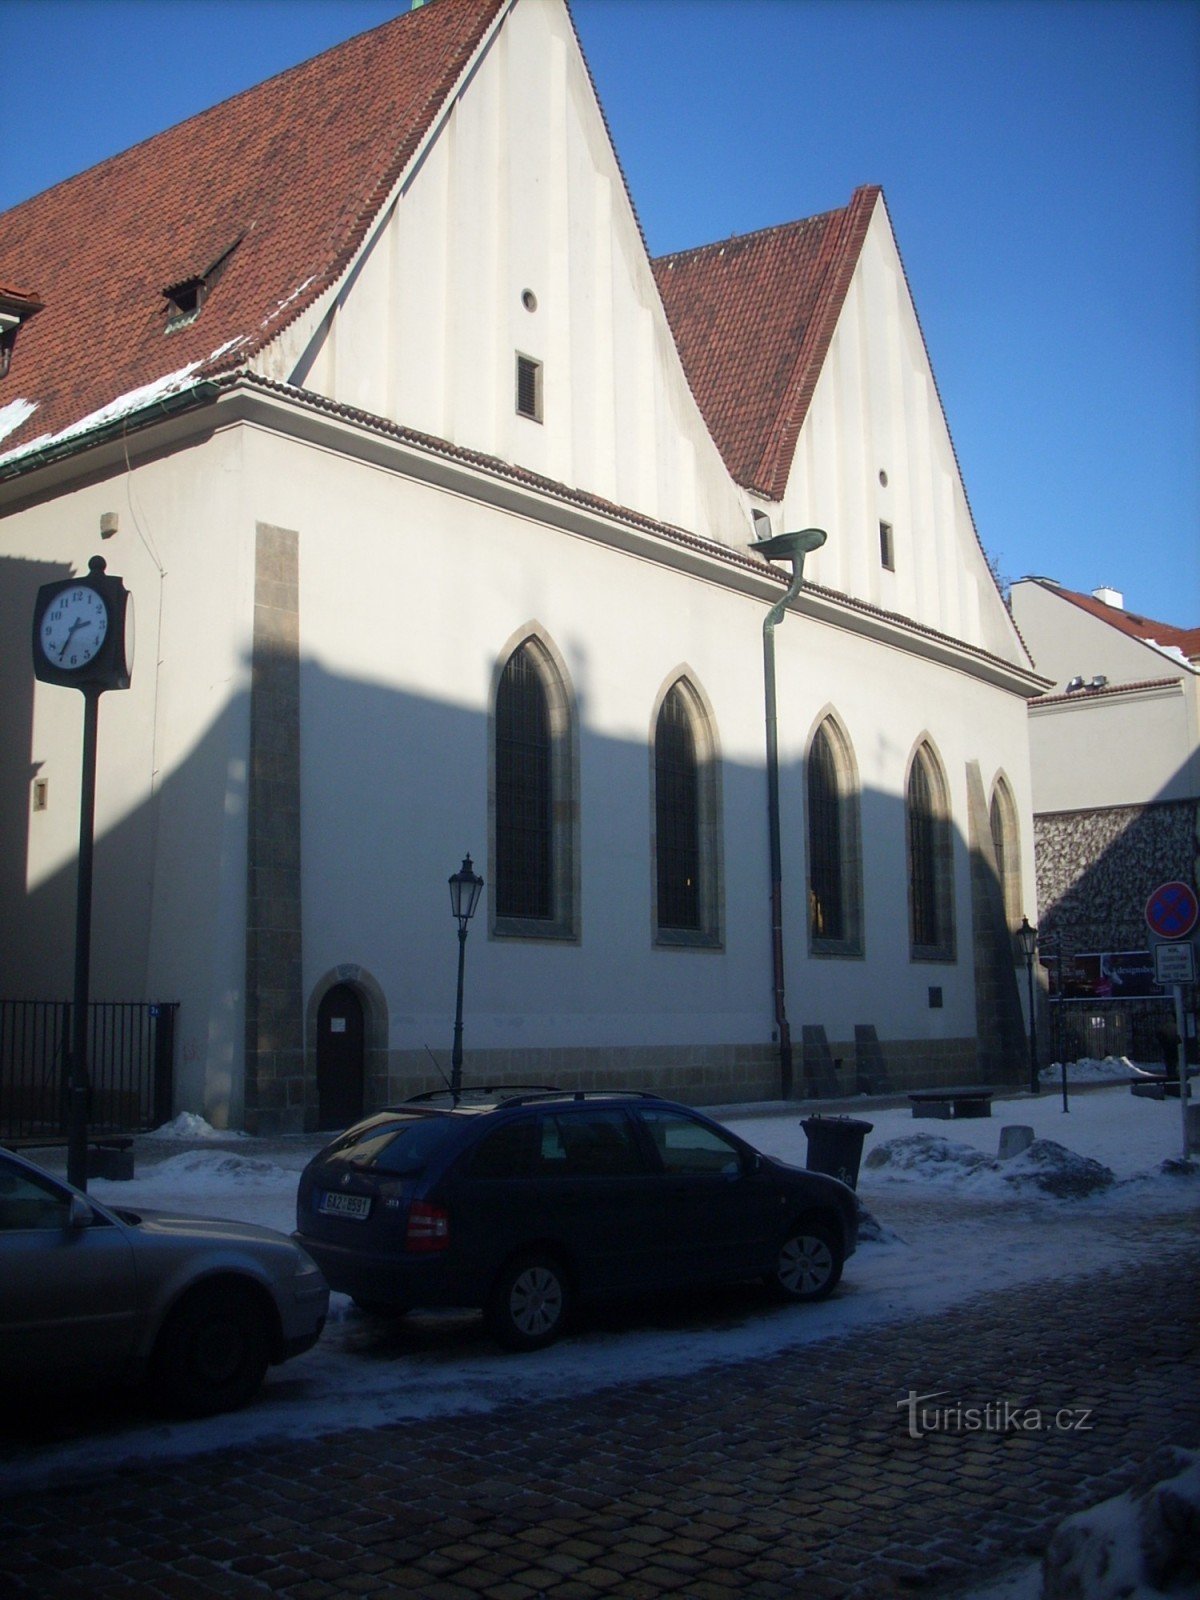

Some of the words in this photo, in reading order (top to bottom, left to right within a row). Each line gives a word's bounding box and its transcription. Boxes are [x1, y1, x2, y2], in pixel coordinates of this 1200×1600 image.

[72, 591, 83, 602] 12
[60, 598, 69, 608] 11
[95, 604, 103, 614] 2
[50, 611, 61, 621] 10
[99, 620, 106, 629] 3
[45, 627, 52, 636] 9
[48, 641, 56, 650] 8
[93, 636, 100, 646] 4
[83, 649, 91, 659] 5
[70, 655, 77, 665] 6
